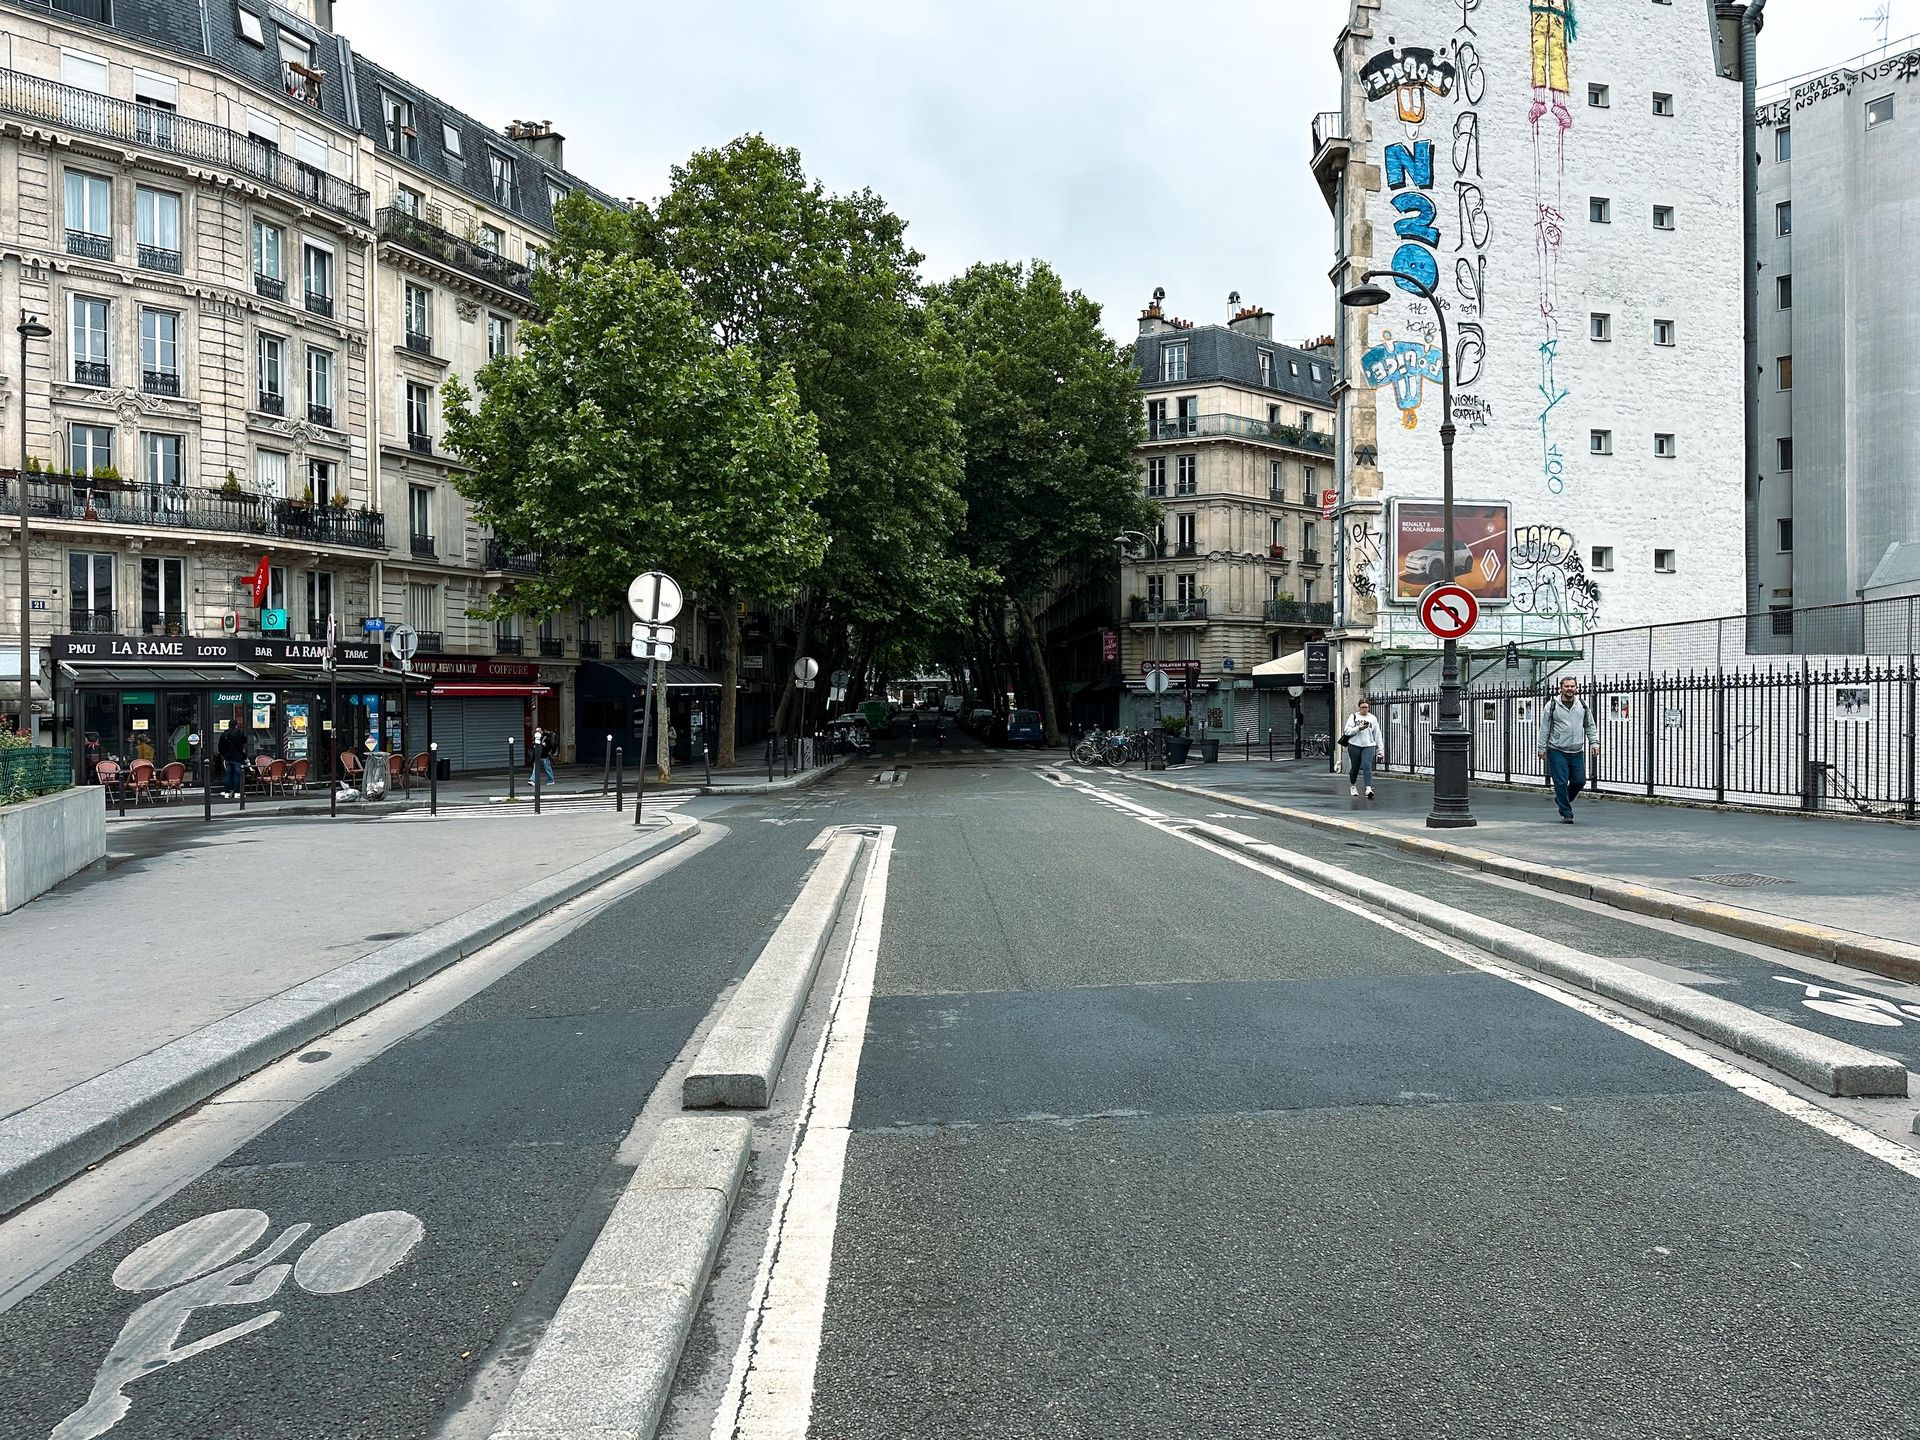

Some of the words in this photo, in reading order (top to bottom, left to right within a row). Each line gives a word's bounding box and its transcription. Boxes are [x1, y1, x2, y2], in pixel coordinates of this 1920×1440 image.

[1794, 73, 1840, 100] RURALS
[255, 568, 264, 596] TABAC
[34, 601, 43, 609] 21
[68, 643, 96, 654] PMU
[111, 641, 133, 655] LA
[136, 641, 184, 656] RAME
[197, 646, 227, 656] LOTO
[255, 647, 273, 657] BAR
[285, 645, 300, 657] LA
[344, 649, 369, 659] TABAC
[489, 664, 529, 675] COIFFURE
